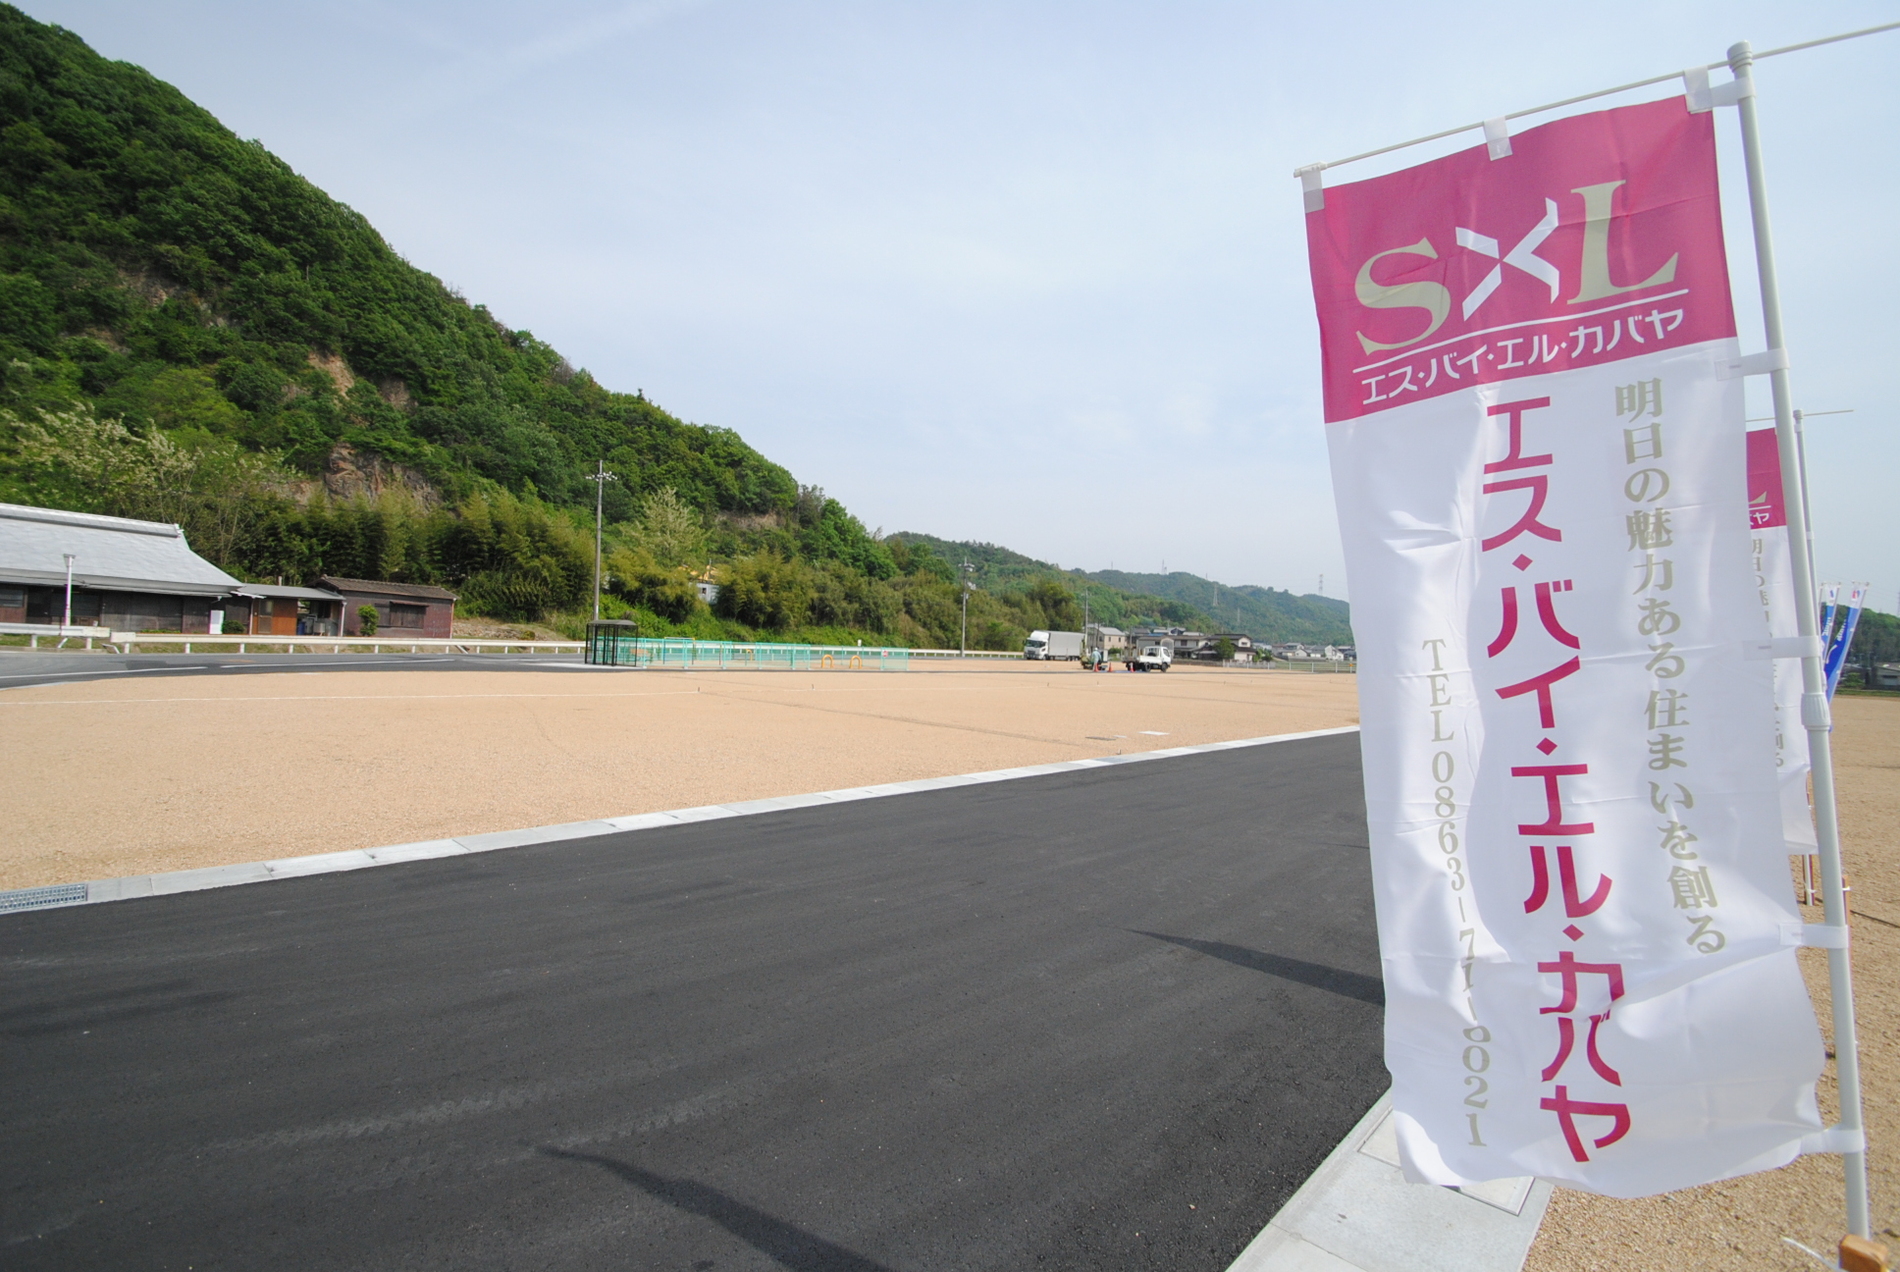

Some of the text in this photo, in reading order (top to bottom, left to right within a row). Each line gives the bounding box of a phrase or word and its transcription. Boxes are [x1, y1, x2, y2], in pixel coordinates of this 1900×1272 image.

[1361, 308, 1684, 405] エス・バイ・エル・カバヤ
[1615, 377, 1726, 954] 明日の魅力ある住まいを創る
